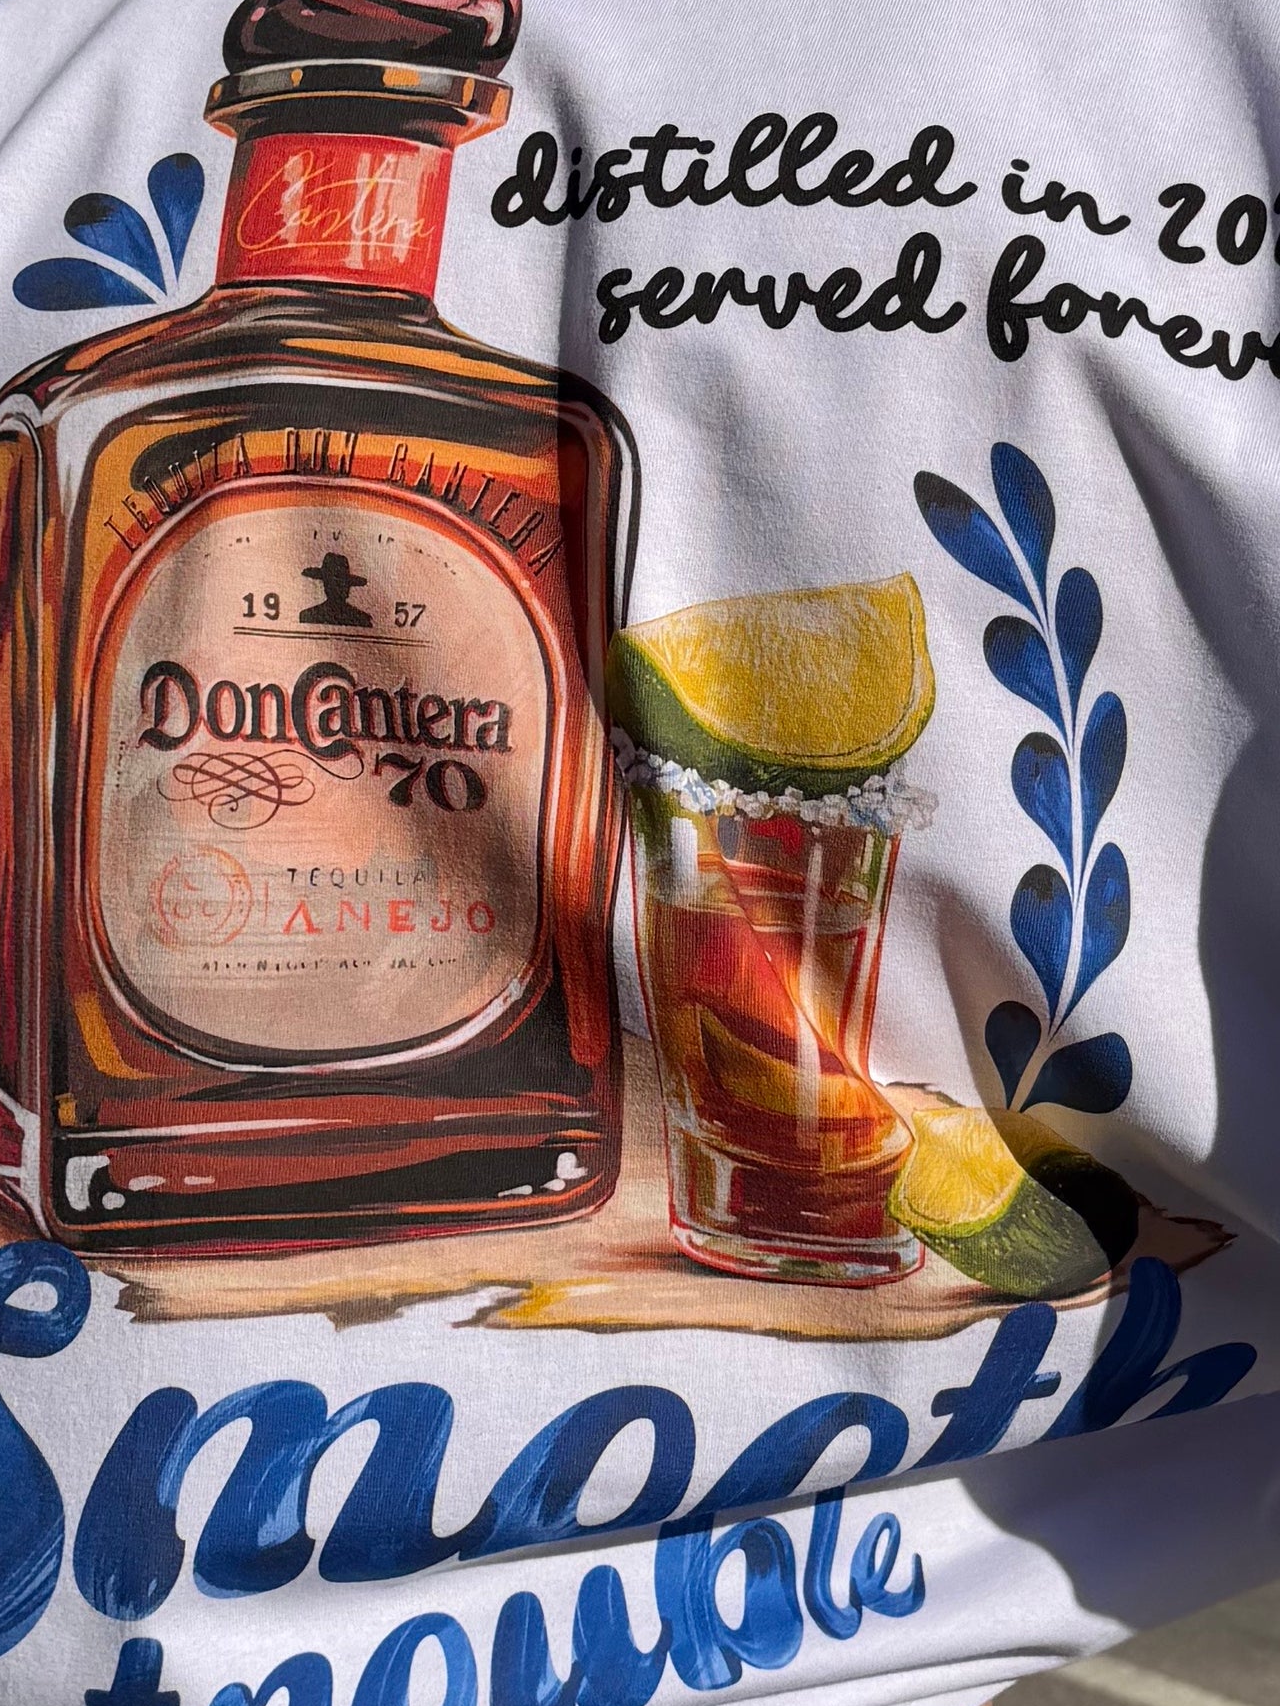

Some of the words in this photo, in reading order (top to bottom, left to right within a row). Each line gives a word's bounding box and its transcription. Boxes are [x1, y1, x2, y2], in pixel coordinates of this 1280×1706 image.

[491, 111, 977, 229] distilled
[1002, 158, 1131, 237] in
[597, 232, 967, 345] served
[242, 592, 281, 621] 19
[394, 601, 428, 628] 57
[374, 751, 488, 812] 70
[286, 867, 430, 890] TEQUILA
